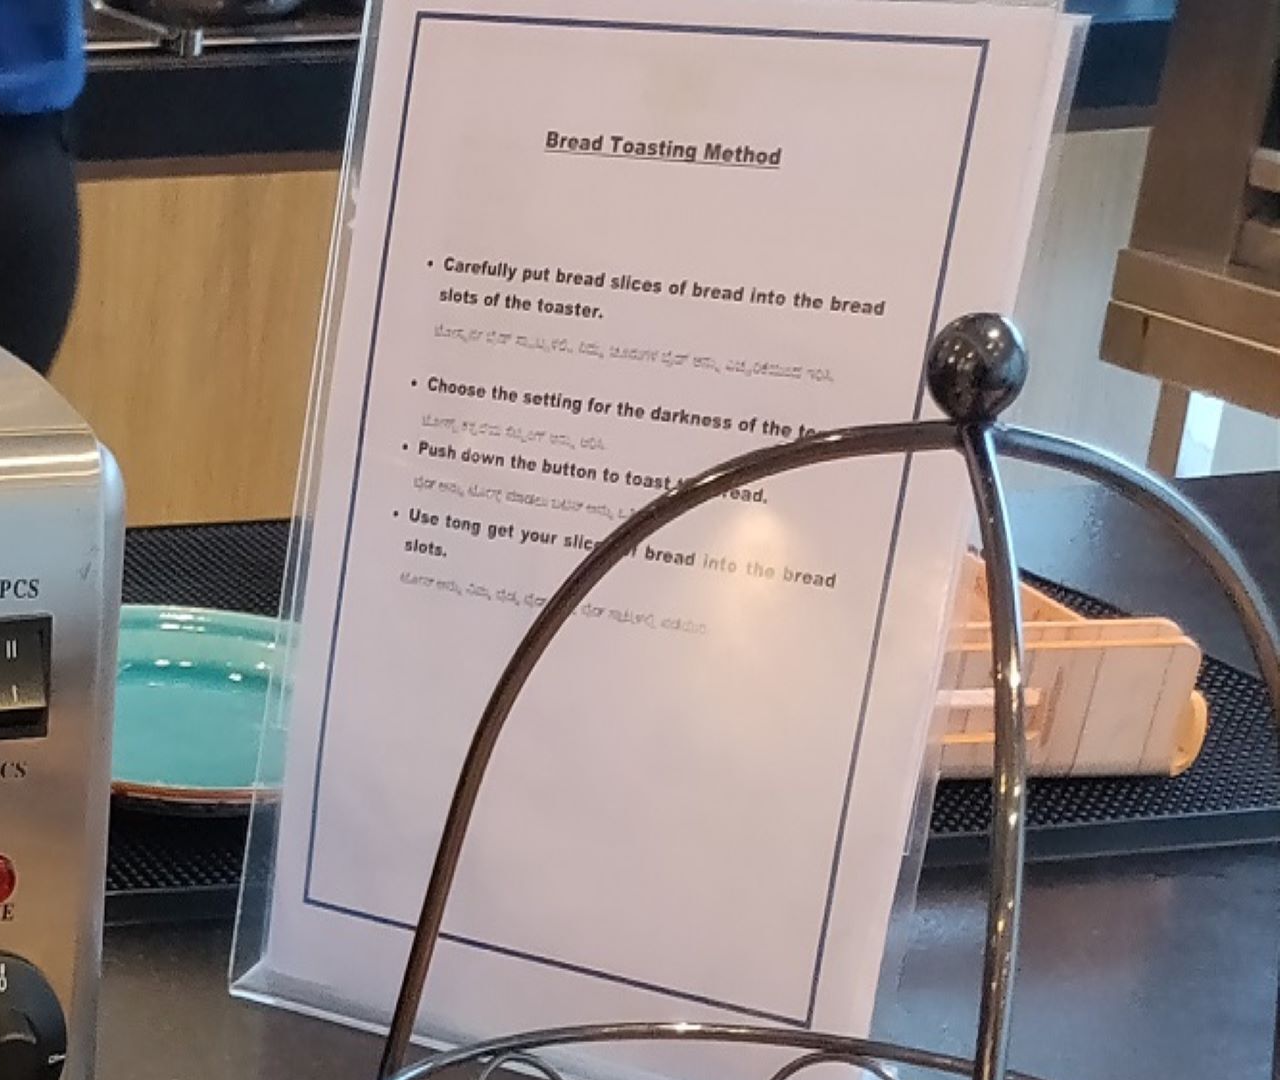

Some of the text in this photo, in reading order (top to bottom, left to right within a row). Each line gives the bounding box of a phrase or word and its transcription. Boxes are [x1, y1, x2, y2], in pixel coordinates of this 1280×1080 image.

[545, 130, 782, 166] Bread Toasting Method
[439, 287, 604, 319] slots of the toaster.
[443, 256, 887, 317] Carefully put bread slices of bread into the bread
[427, 376, 487, 399] Choose
[491, 385, 519, 403] the
[522, 392, 583, 416] setting
[587, 397, 612, 415] for
[616, 402, 645, 420] the
[650, 405, 733, 431] darkness
[737, 416, 758, 433] of
[762, 420, 793, 439] the
[418, 440, 457, 460] Push
[460, 447, 505, 468] down
[510, 455, 537, 472] the
[541, 458, 597, 481] button
[602, 467, 620, 484] to
[625, 470, 671, 490] toast
[404, 538, 448, 558] slots.
[408, 507, 440, 527] Use
[444, 514, 481, 538] tong
[487, 523, 515, 541] get
[519, 528, 558, 545] your
[644, 544, 697, 567] bread
[702, 553, 738, 574] into
[745, 561, 776, 579] the
[782, 566, 837, 589] bread
